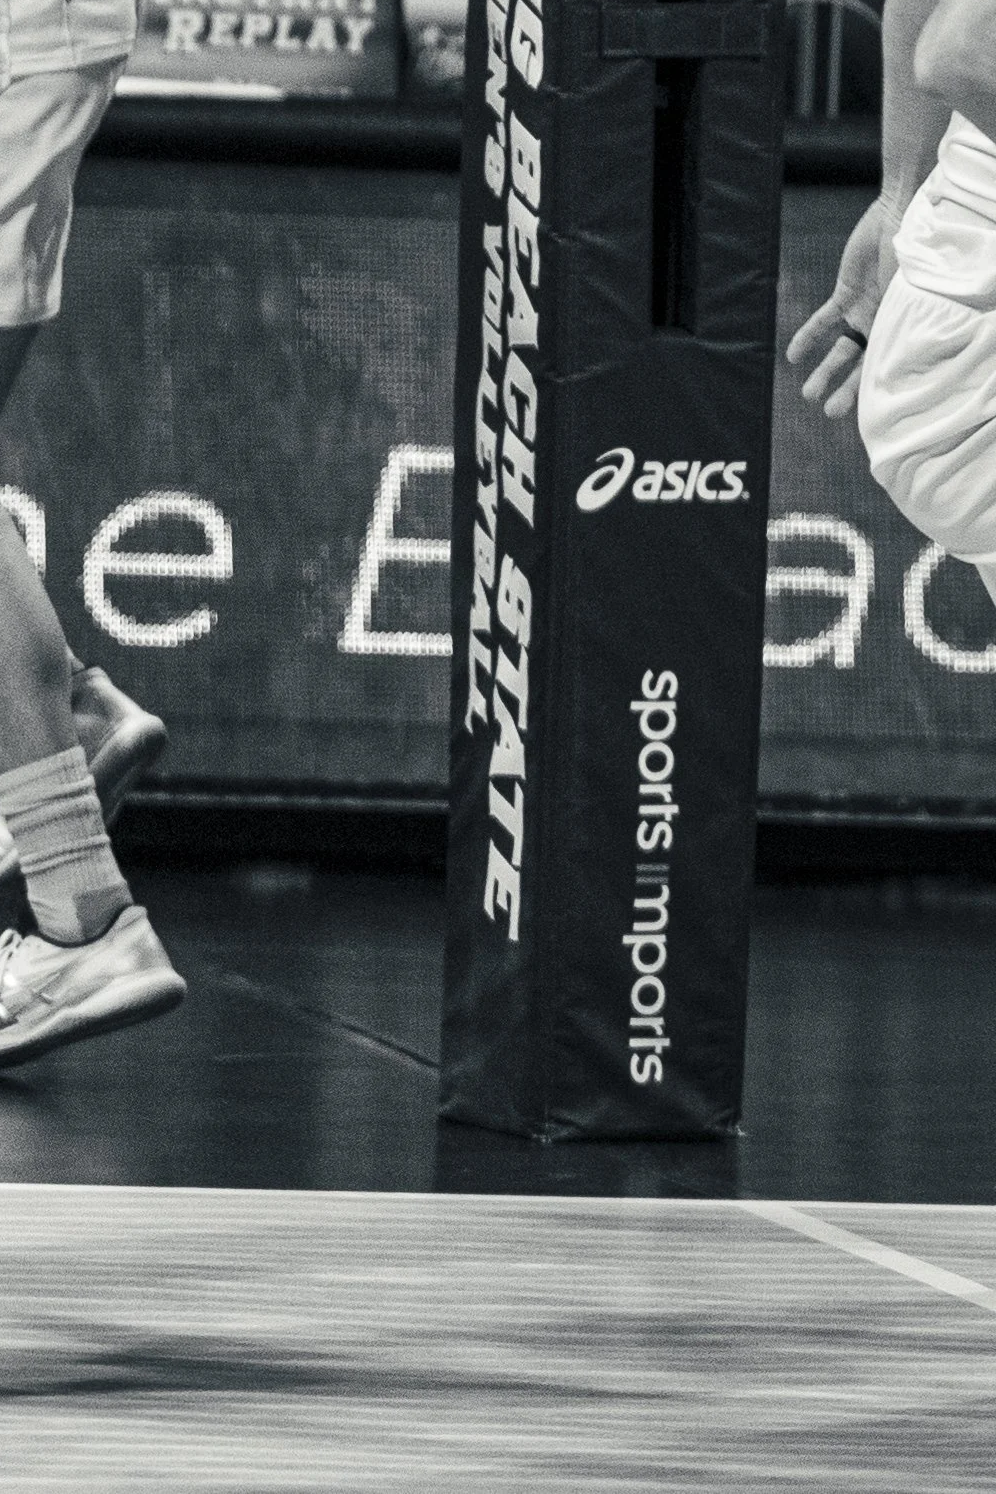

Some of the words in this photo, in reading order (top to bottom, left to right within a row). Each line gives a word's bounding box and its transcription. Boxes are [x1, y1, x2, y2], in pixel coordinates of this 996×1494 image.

[464, 221, 504, 736] VOLLEYBALL
[502, 108, 542, 531] BEACH
[484, 554, 533, 942] STATE
